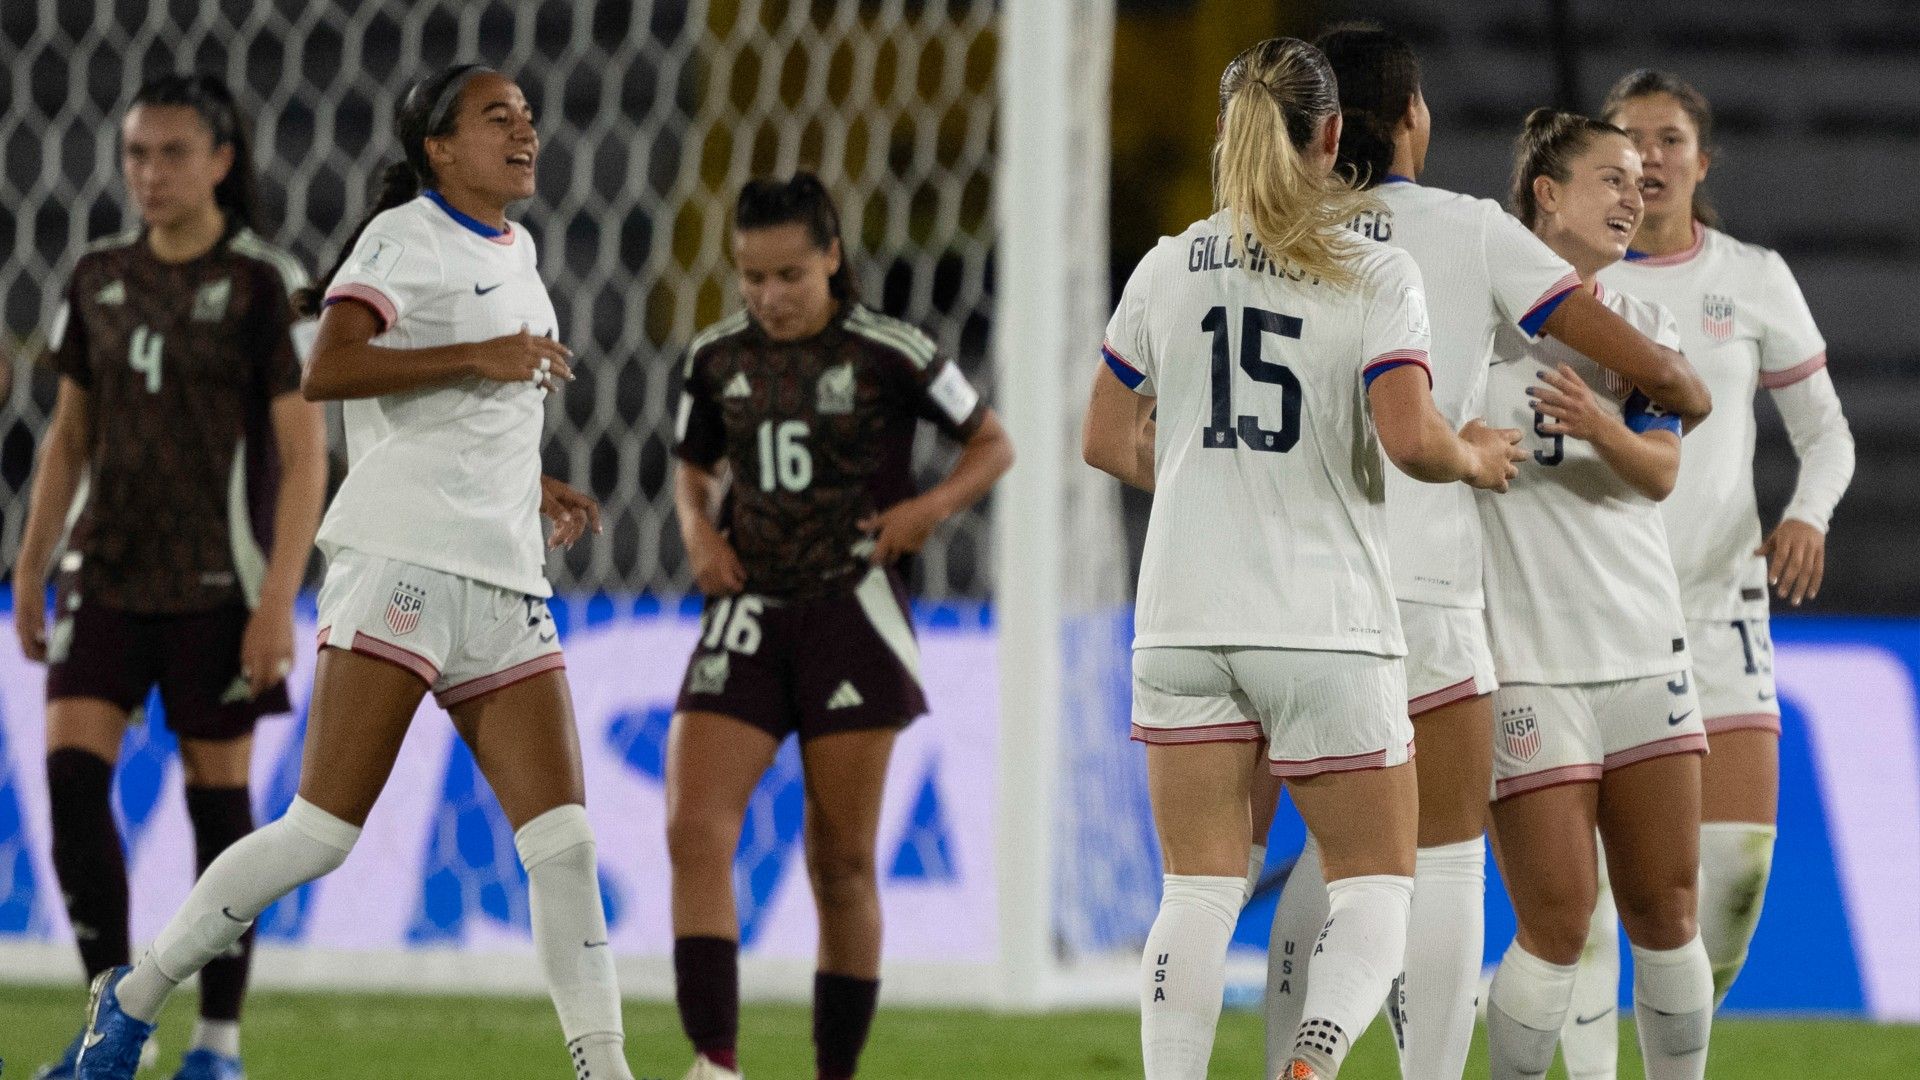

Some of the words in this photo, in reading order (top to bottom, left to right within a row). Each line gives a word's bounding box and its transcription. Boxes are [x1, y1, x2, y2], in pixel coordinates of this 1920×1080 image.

[1705, 303, 1732, 320] USA
[129, 328, 163, 394] 4
[1201, 306, 1303, 453] 15
[758, 420, 813, 492] 16
[394, 591, 422, 612] USA
[703, 594, 764, 657] 16
[1505, 718, 1534, 737] USA
[1154, 953, 1169, 1002] USA
[1280, 941, 1295, 995] USA
